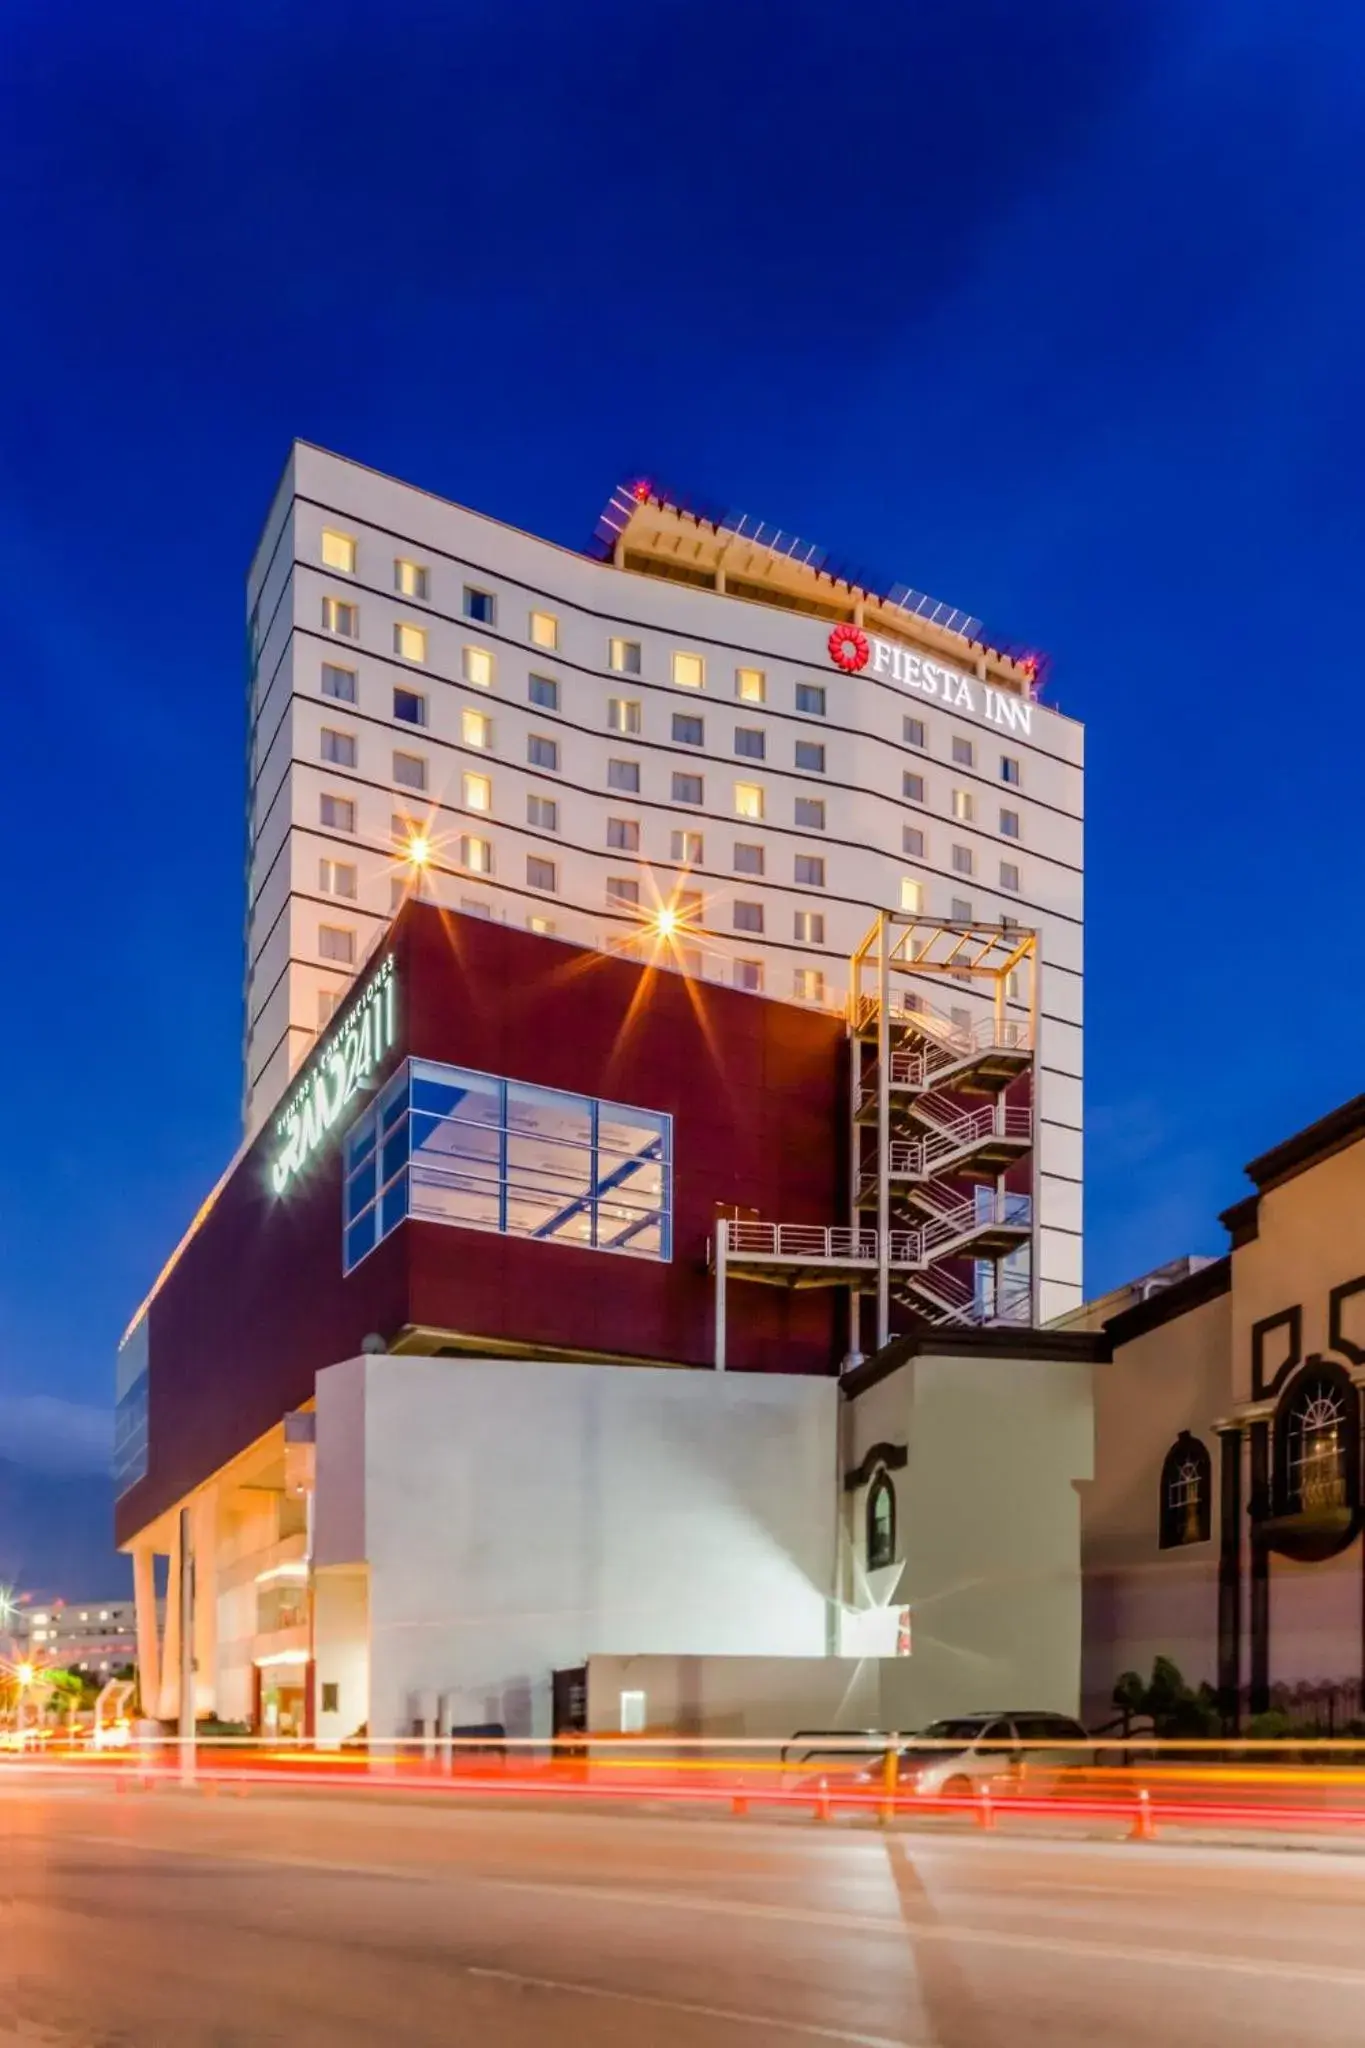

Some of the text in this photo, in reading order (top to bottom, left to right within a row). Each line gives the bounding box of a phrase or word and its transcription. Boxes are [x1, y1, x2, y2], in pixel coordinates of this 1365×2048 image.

[872, 637, 1034, 736] FIESTA INN
[320, 952, 394, 1070] CONVENCIONES
